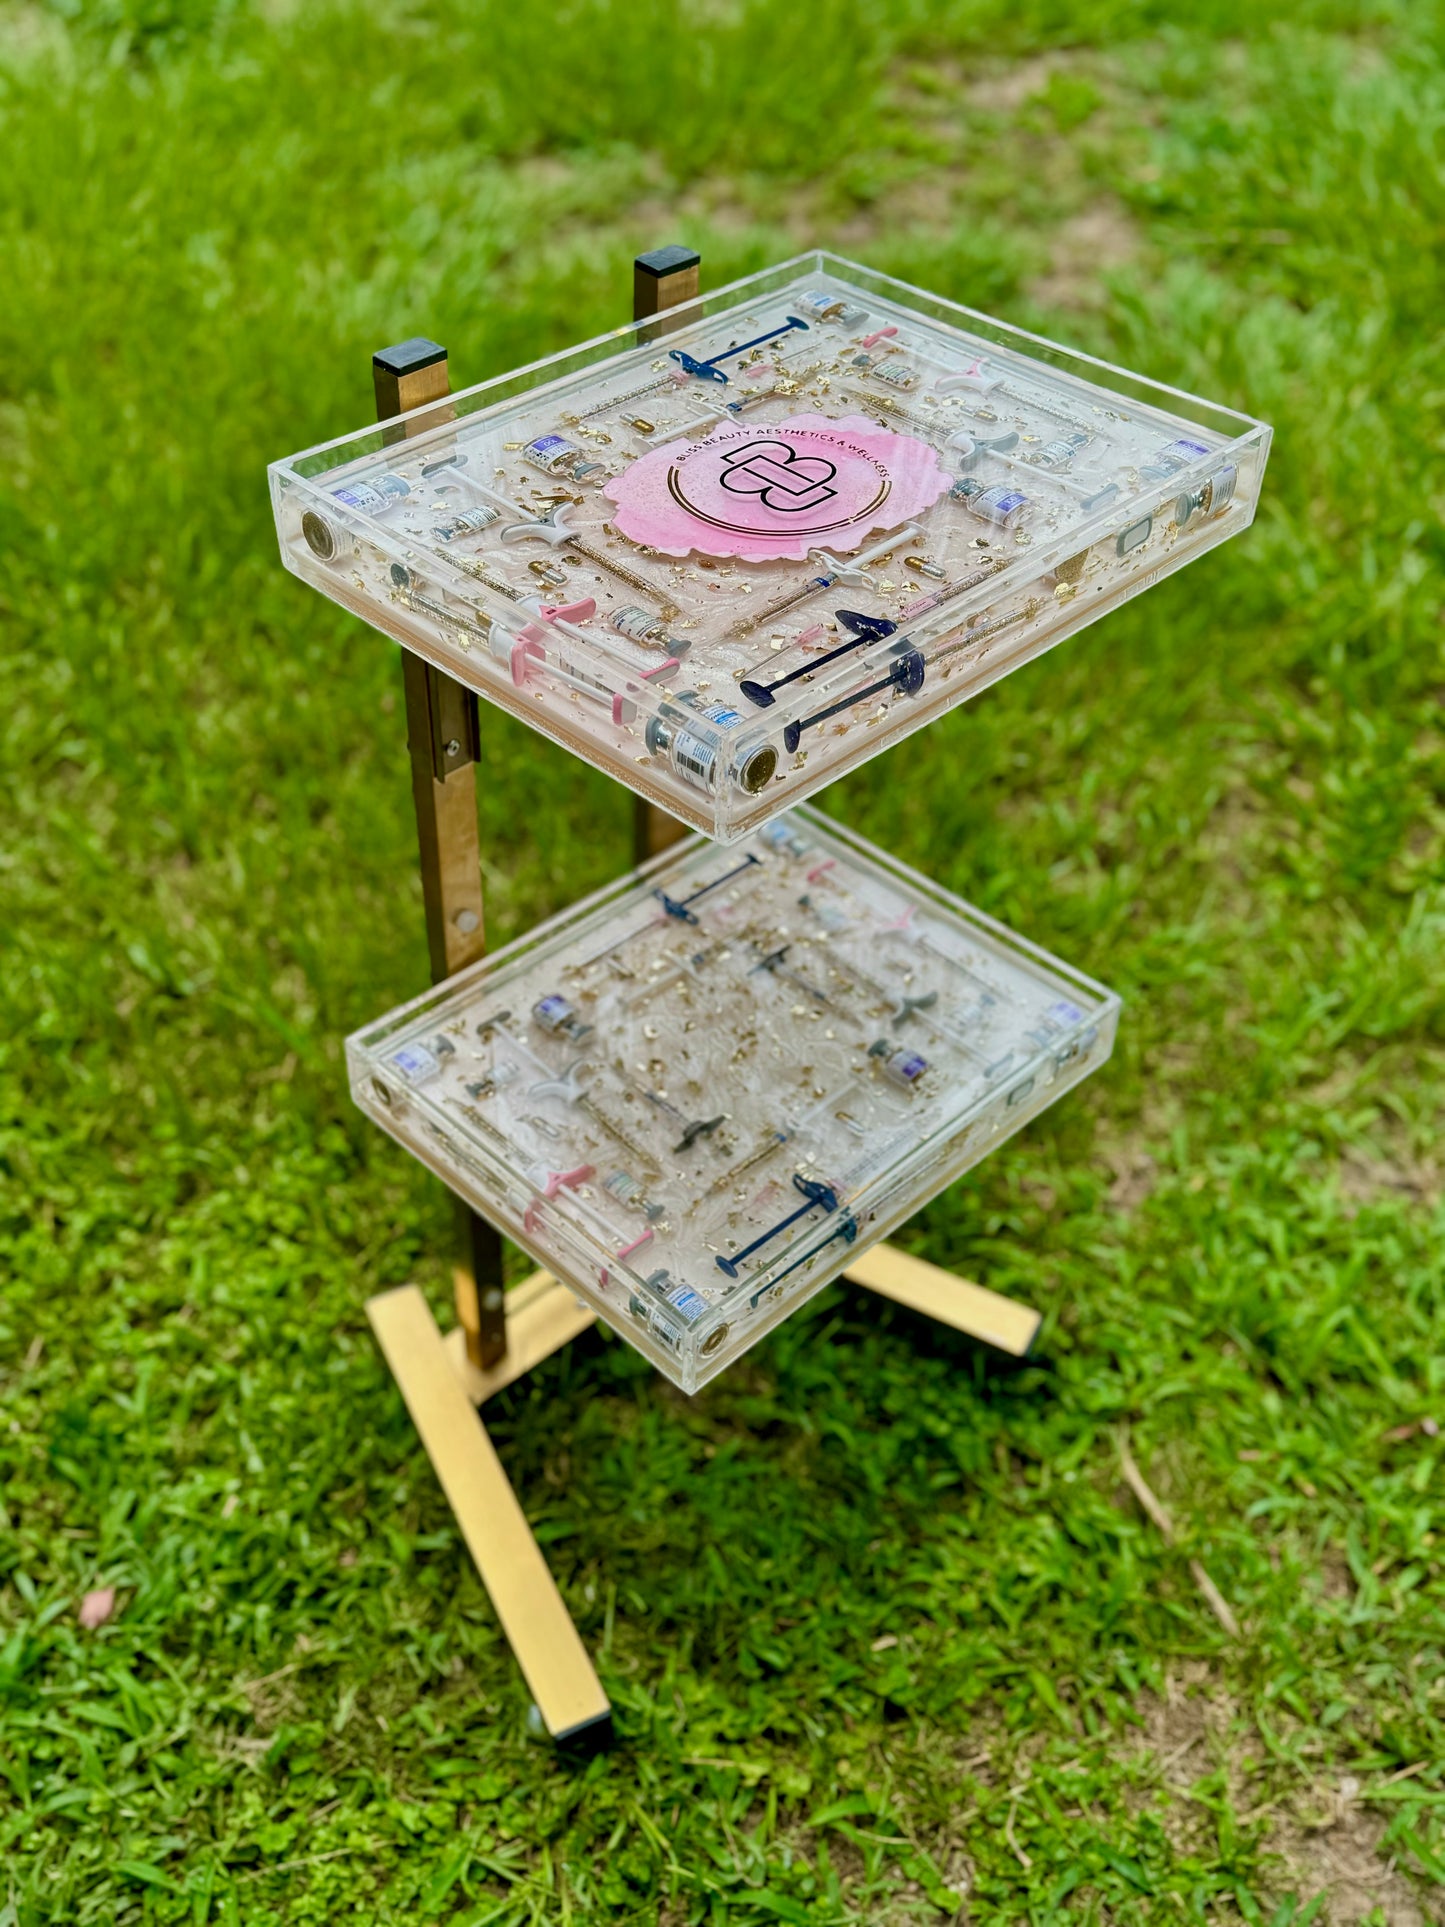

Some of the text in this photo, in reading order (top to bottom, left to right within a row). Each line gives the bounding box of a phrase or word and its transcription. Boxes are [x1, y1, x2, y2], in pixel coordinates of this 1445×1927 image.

[676, 444, 703, 462] BLISS
[702, 430, 750, 446] BEAUTY
[756, 428, 836, 442] AESTHETICS
[848, 443, 890, 478] WELLNESS
